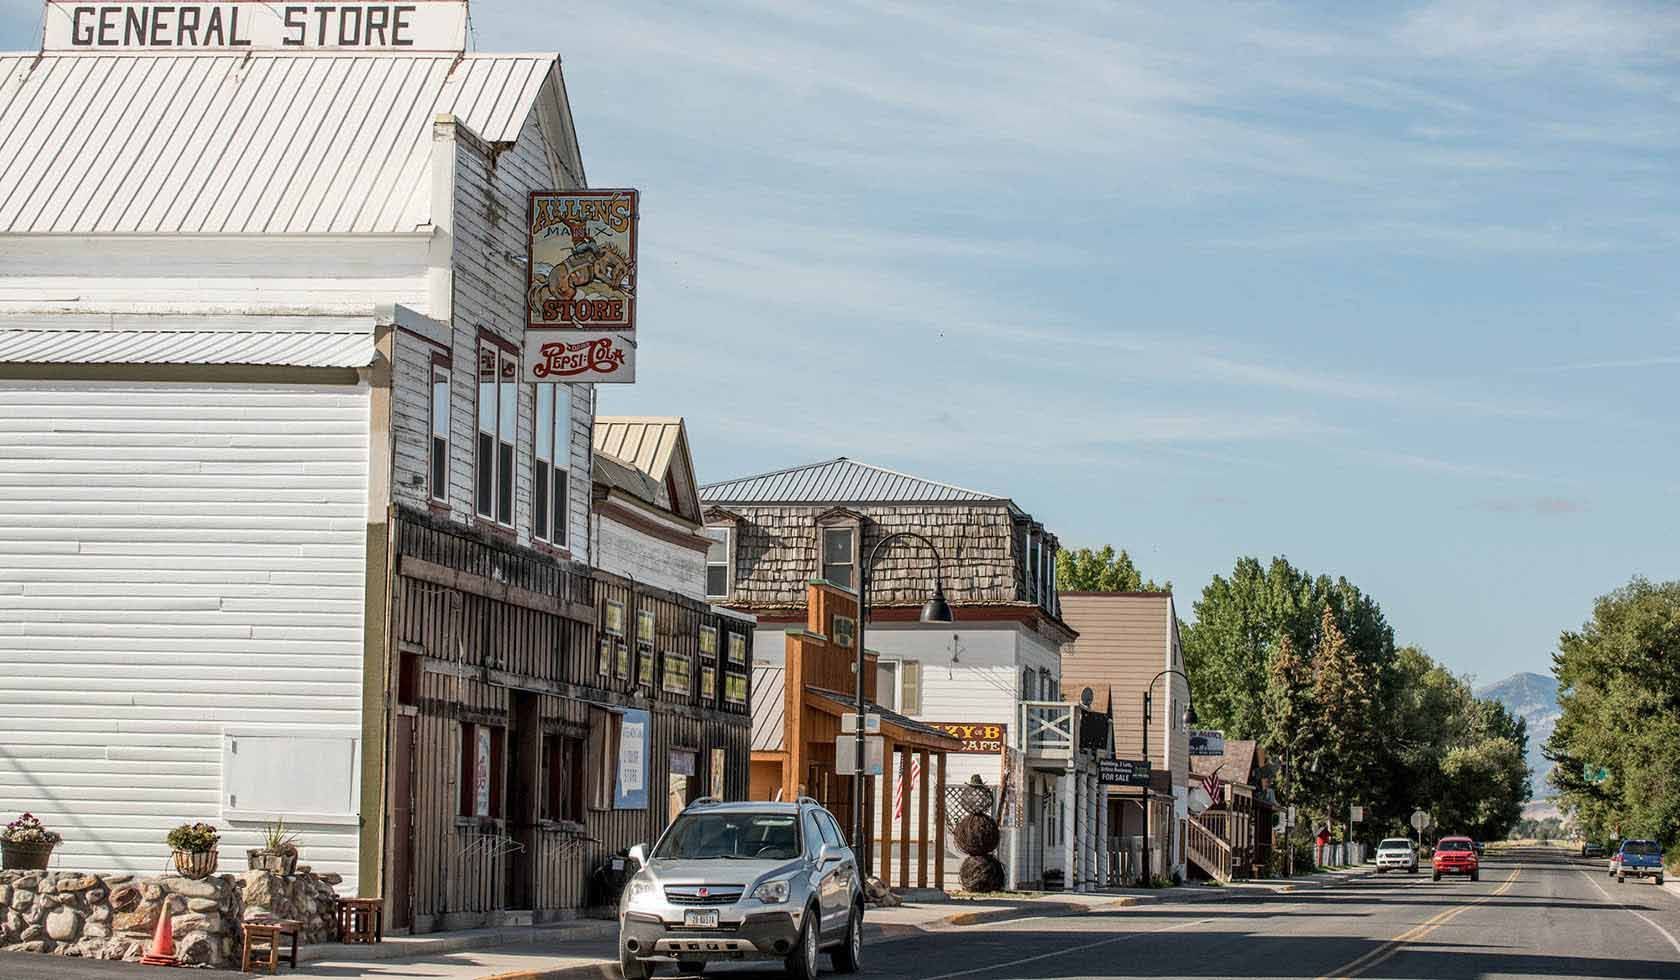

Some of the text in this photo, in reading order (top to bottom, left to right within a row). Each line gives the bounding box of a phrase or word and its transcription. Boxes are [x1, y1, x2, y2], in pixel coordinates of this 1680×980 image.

[71, 5, 416, 46] GENERAL STORE
[533, 193, 629, 234] ALLEN'S
[542, 299, 624, 322] STORE
[983, 726, 1000, 739] B
[1115, 774, 1129, 782] SALE
